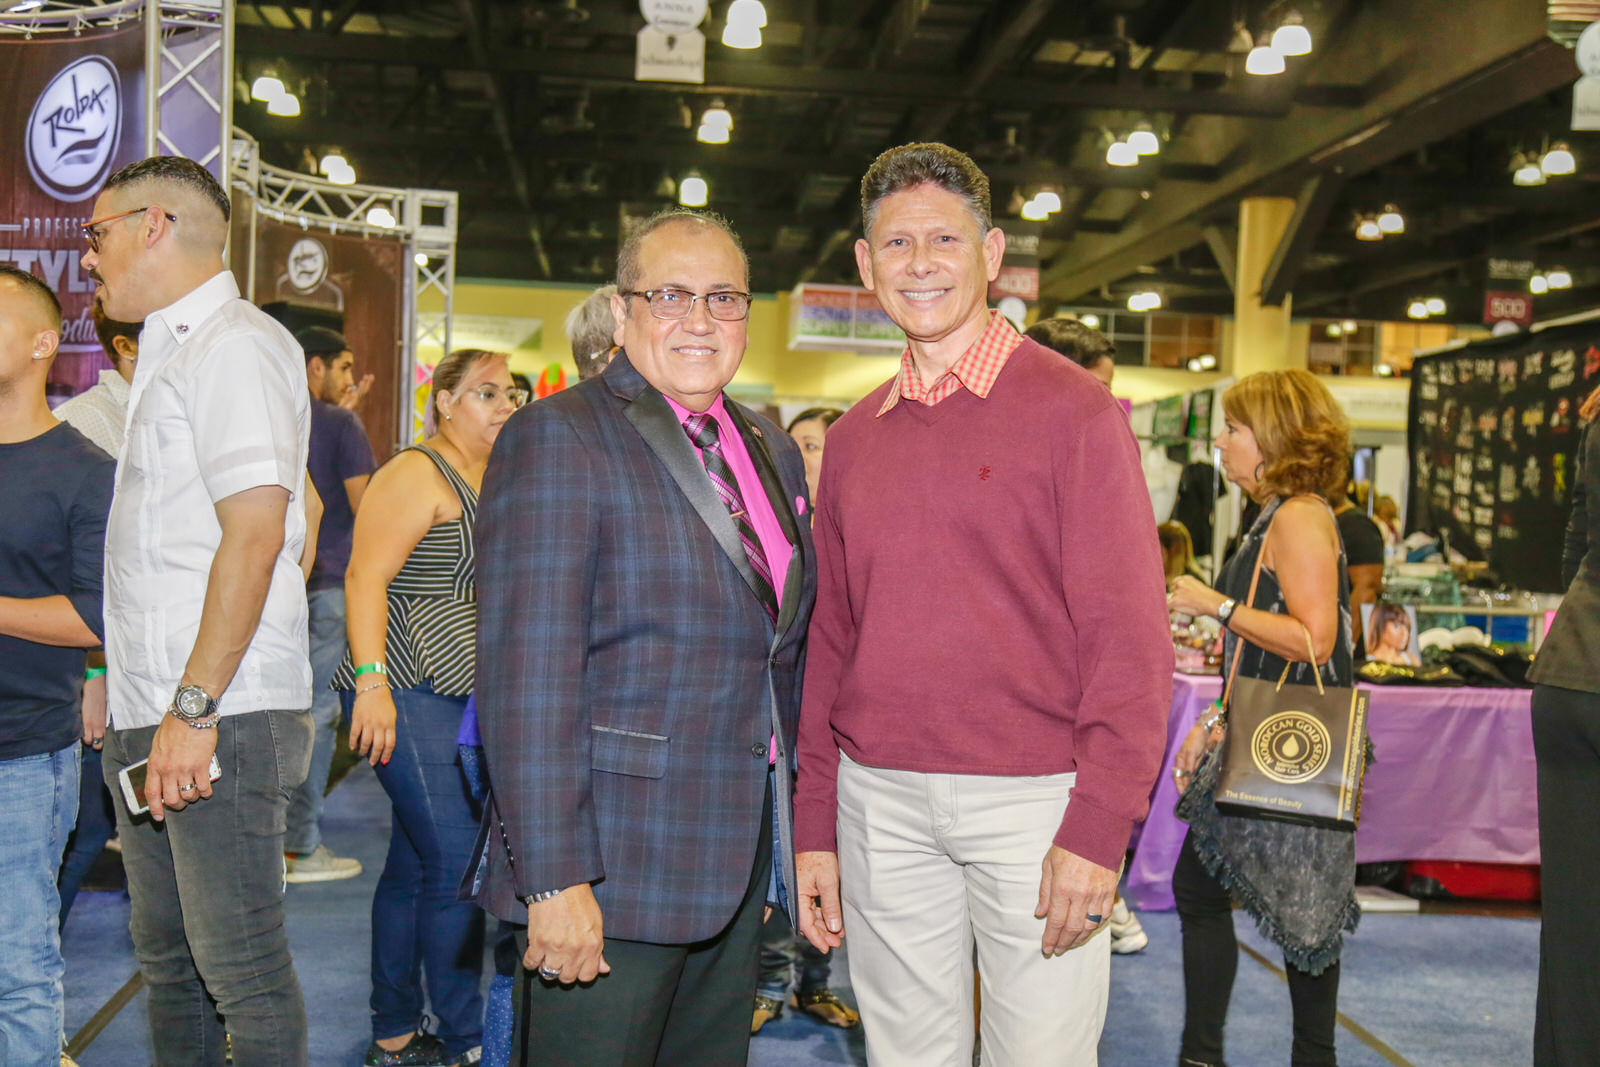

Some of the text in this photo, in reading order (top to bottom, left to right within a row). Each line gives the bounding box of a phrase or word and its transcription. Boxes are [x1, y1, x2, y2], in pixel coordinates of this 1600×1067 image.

[1490, 297, 1526, 319] 500
[1260, 719, 1322, 772] MOROCCAN GOLD SERIES
[1225, 789, 1303, 810] The Essence of Beauty
